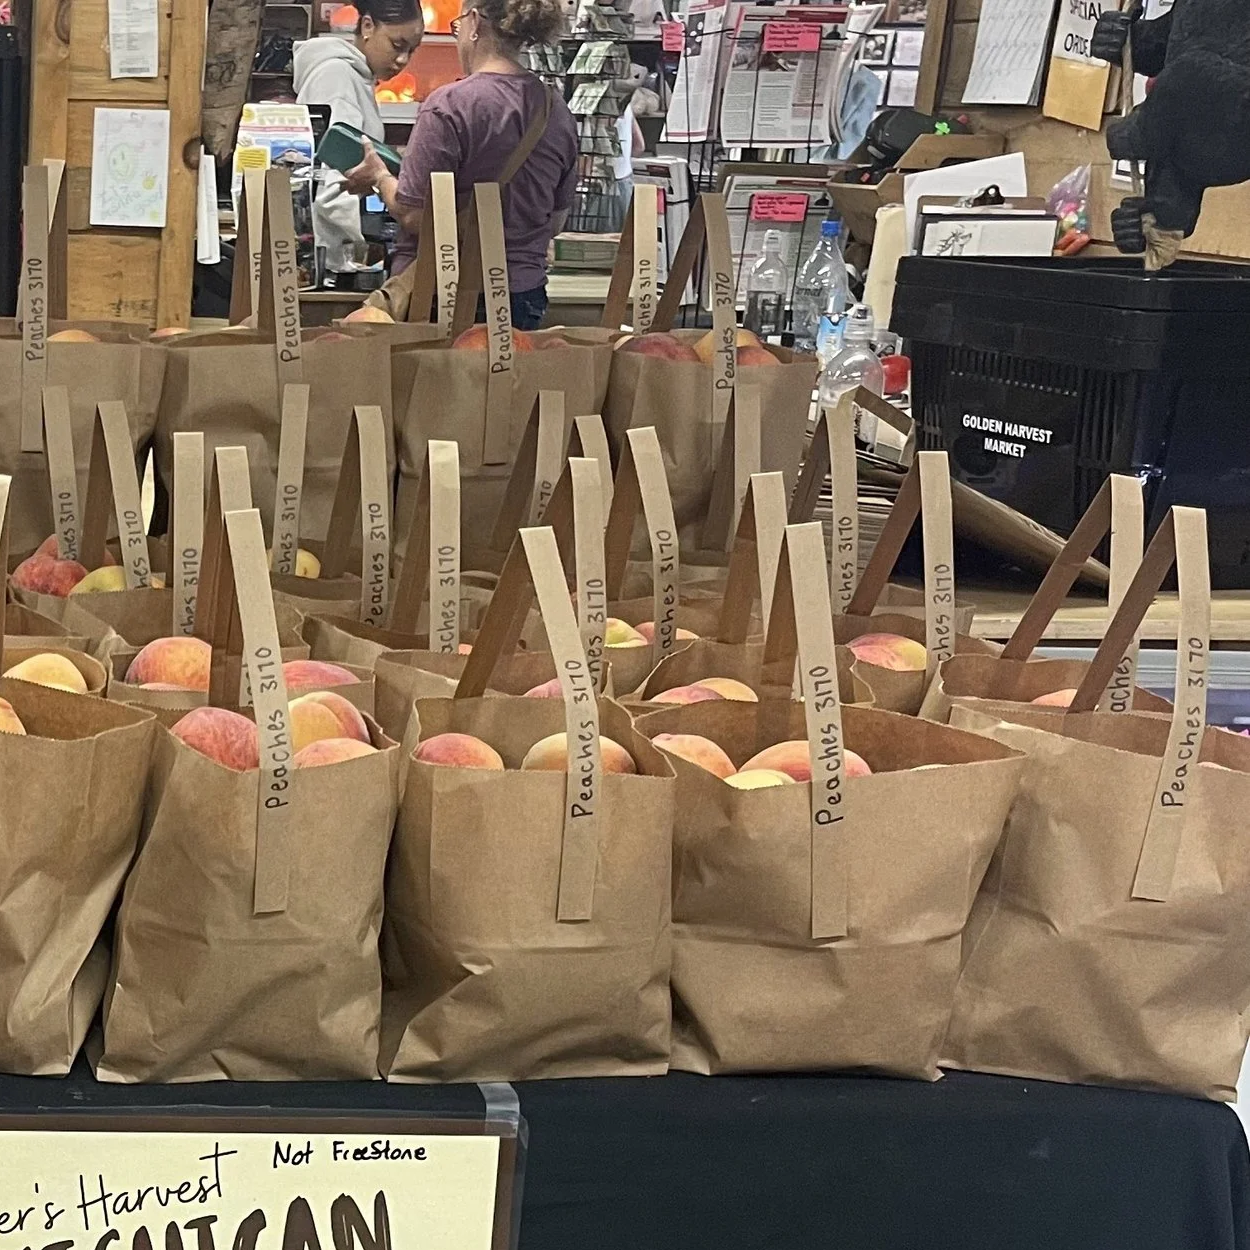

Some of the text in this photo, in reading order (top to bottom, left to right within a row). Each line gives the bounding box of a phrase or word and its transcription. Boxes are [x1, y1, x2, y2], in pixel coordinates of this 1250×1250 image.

[274, 240, 301, 362] Peaches 3170
[440, 244, 456, 272] 3170
[638, 259, 651, 335] aches 3170
[24, 258, 44, 361] Peaches 3170
[489, 267, 512, 373] Peaches 3170
[715, 272, 735, 390] Peaches 3170
[962, 414, 1053, 444] GOLDEN HARVEST
[984, 437, 1027, 458] MARKET
[59, 491, 75, 525] 3170
[124, 510, 141, 548] 3170
[279, 484, 298, 574] ches 3170
[368, 503, 386, 540] 3170
[838, 516, 853, 553] 3170
[180, 548, 199, 635] ches 3170
[438, 546, 456, 587] 3170
[586, 579, 605, 623] 3170
[656, 530, 675, 650] aches 3170
[932, 564, 953, 661] ches 3170
[255, 647, 290, 808] Peaches 3170
[1107, 656, 1133, 712] aches
[1161, 637, 1205, 807] Peaches 3170
[564, 660, 595, 818] Peaches 3170
[808, 666, 845, 825] Peaches 3170
[77, 1141, 239, 1232] Harvest
[273, 1140, 428, 1169] Not FreeStone
